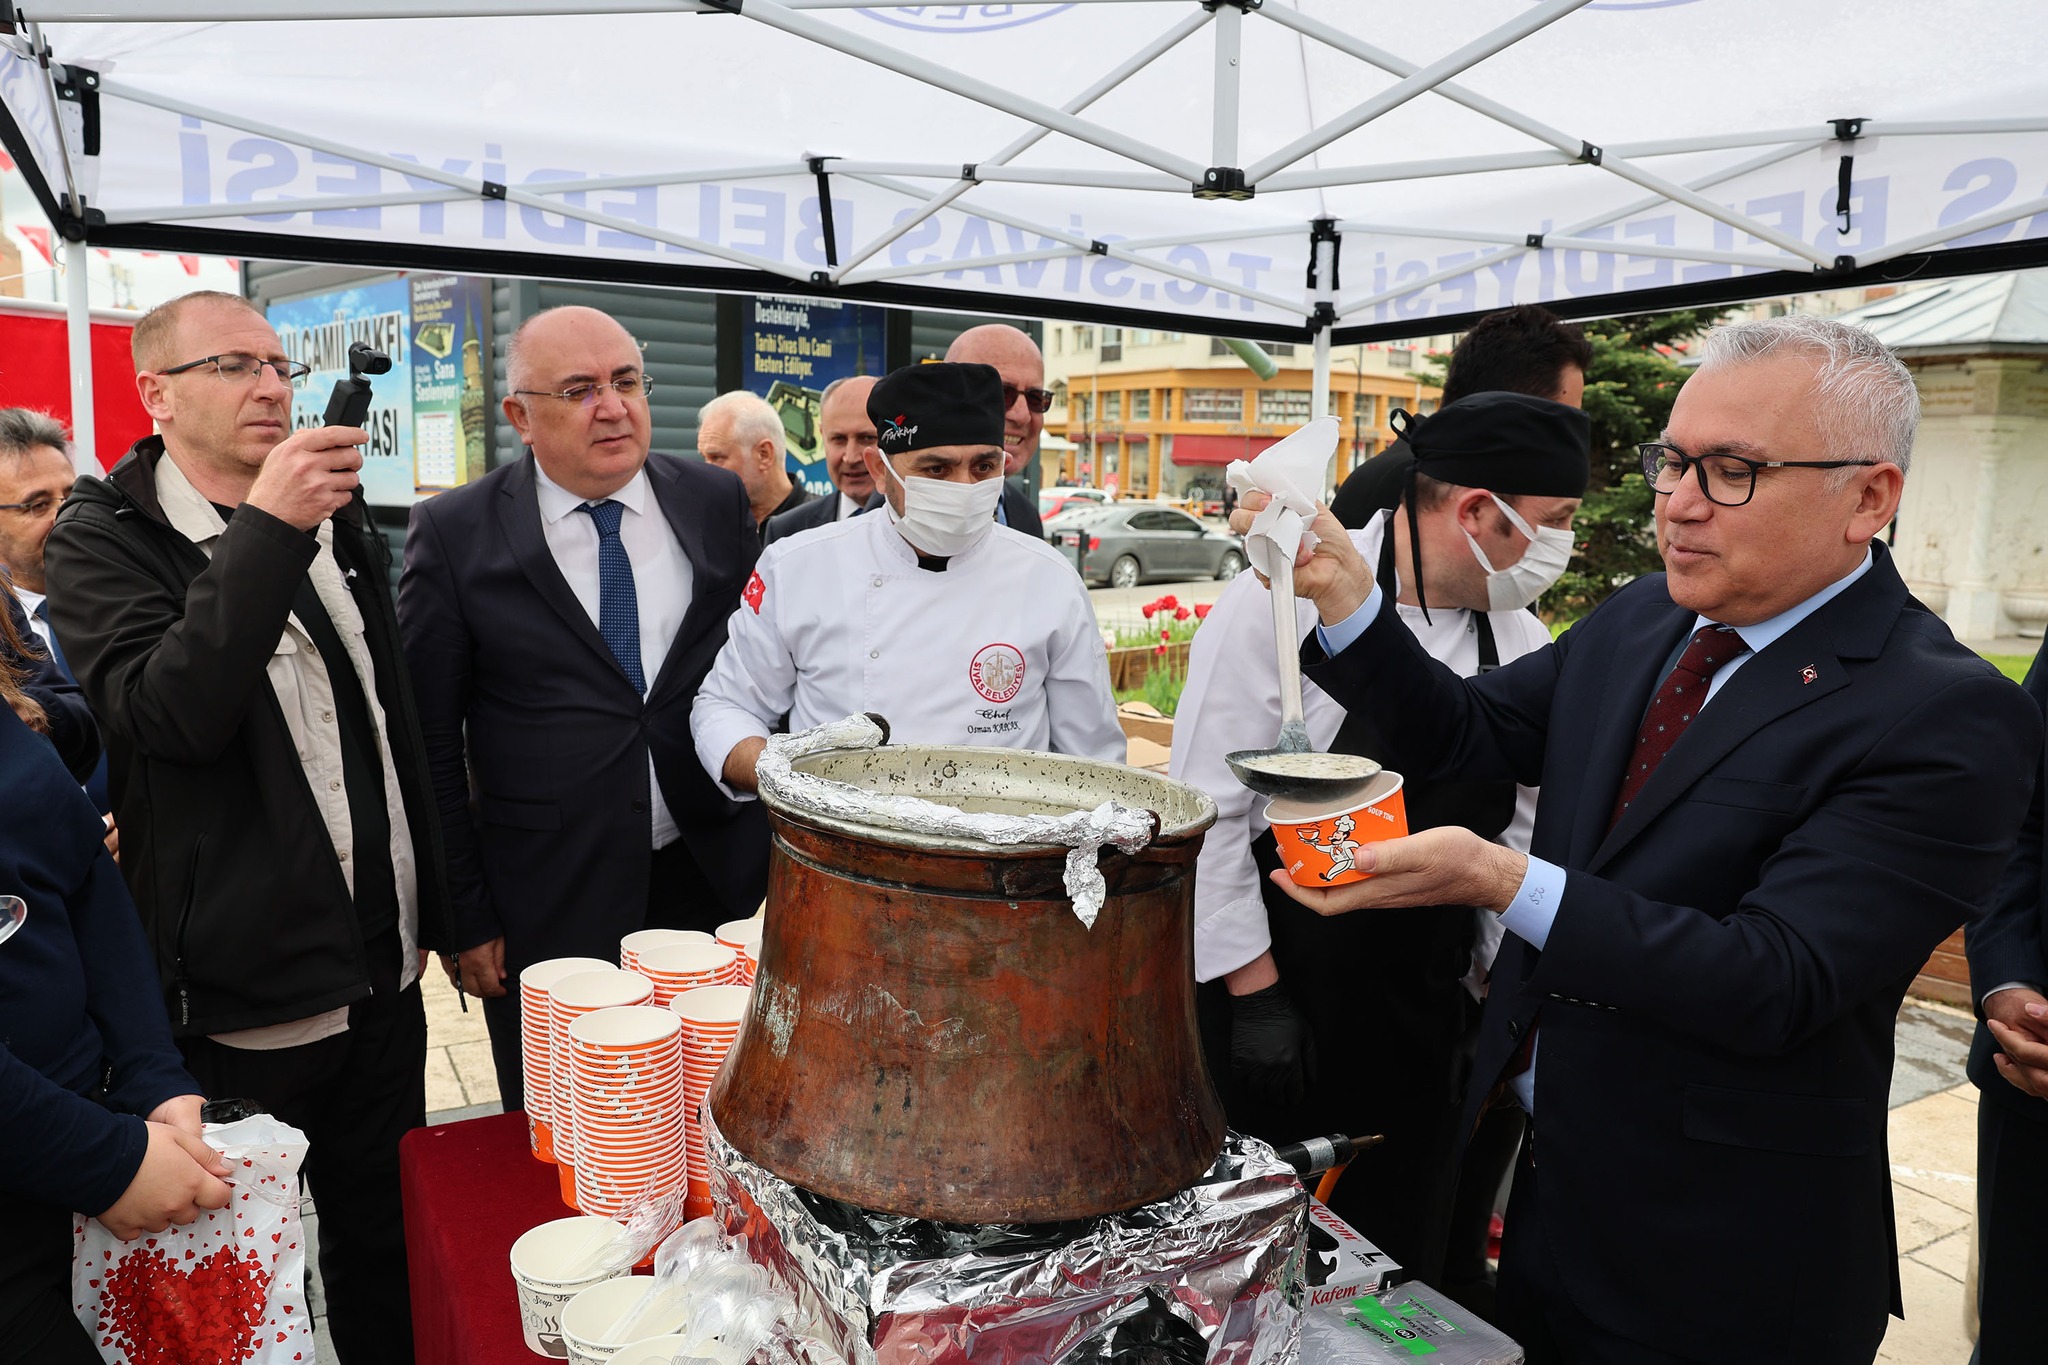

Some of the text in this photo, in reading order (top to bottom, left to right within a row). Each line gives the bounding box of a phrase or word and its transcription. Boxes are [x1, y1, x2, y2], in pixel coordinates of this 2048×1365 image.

[975, 709, 1011, 720] Chef
[968, 725, 991, 734] Osman
[1310, 1204, 1358, 1241] Kafem
[1350, 1250, 1373, 1268] LARGE
[1363, 1251, 1384, 1263] L
[1311, 1285, 1357, 1306] Kafem
